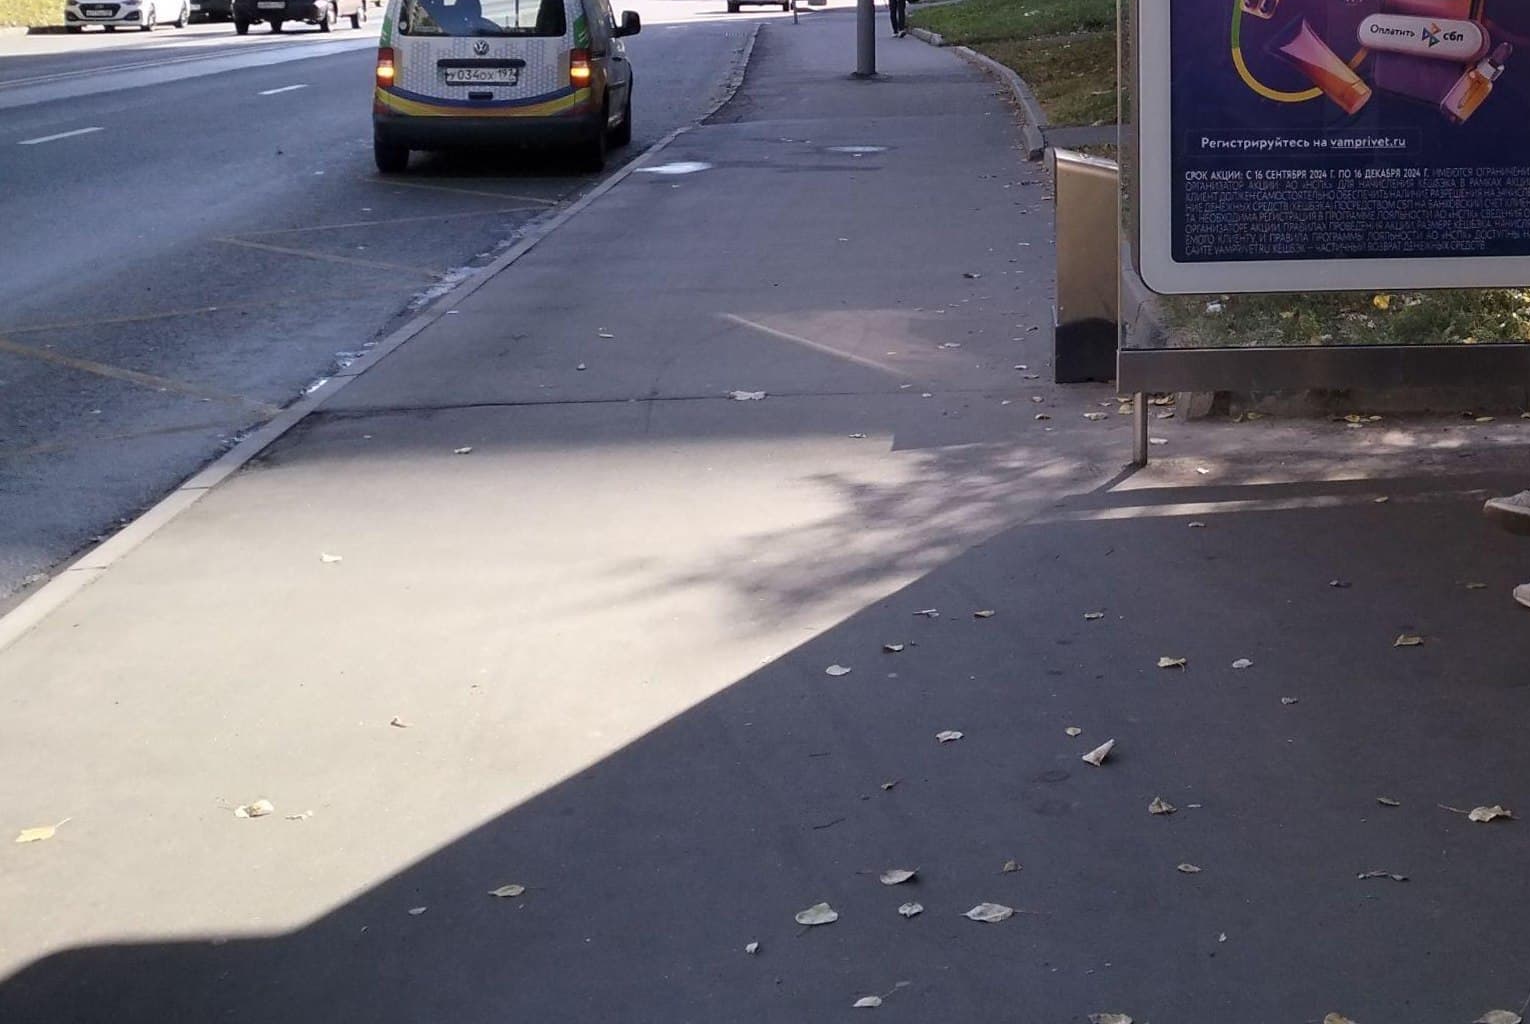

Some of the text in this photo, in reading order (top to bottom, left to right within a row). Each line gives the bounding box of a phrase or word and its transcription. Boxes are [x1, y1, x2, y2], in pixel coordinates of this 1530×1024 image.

[1370, 24, 1464, 42] Оплатить сбп
[1201, 136, 1407, 150] Регистрируйтесь на vamprivet.ru
[1185, 170, 1208, 181] СРОК
[1255, 169, 1264, 180] 16
[1265, 169, 1307, 180] СЕНТЯБРЯ
[1310, 169, 1328, 179] 2024
[1338, 168, 1352, 179] ПО
[1354, 169, 1363, 179] 16
[1364, 168, 1401, 180] ДЕКАБРЯ
[1403, 168, 1421, 178] 2024
